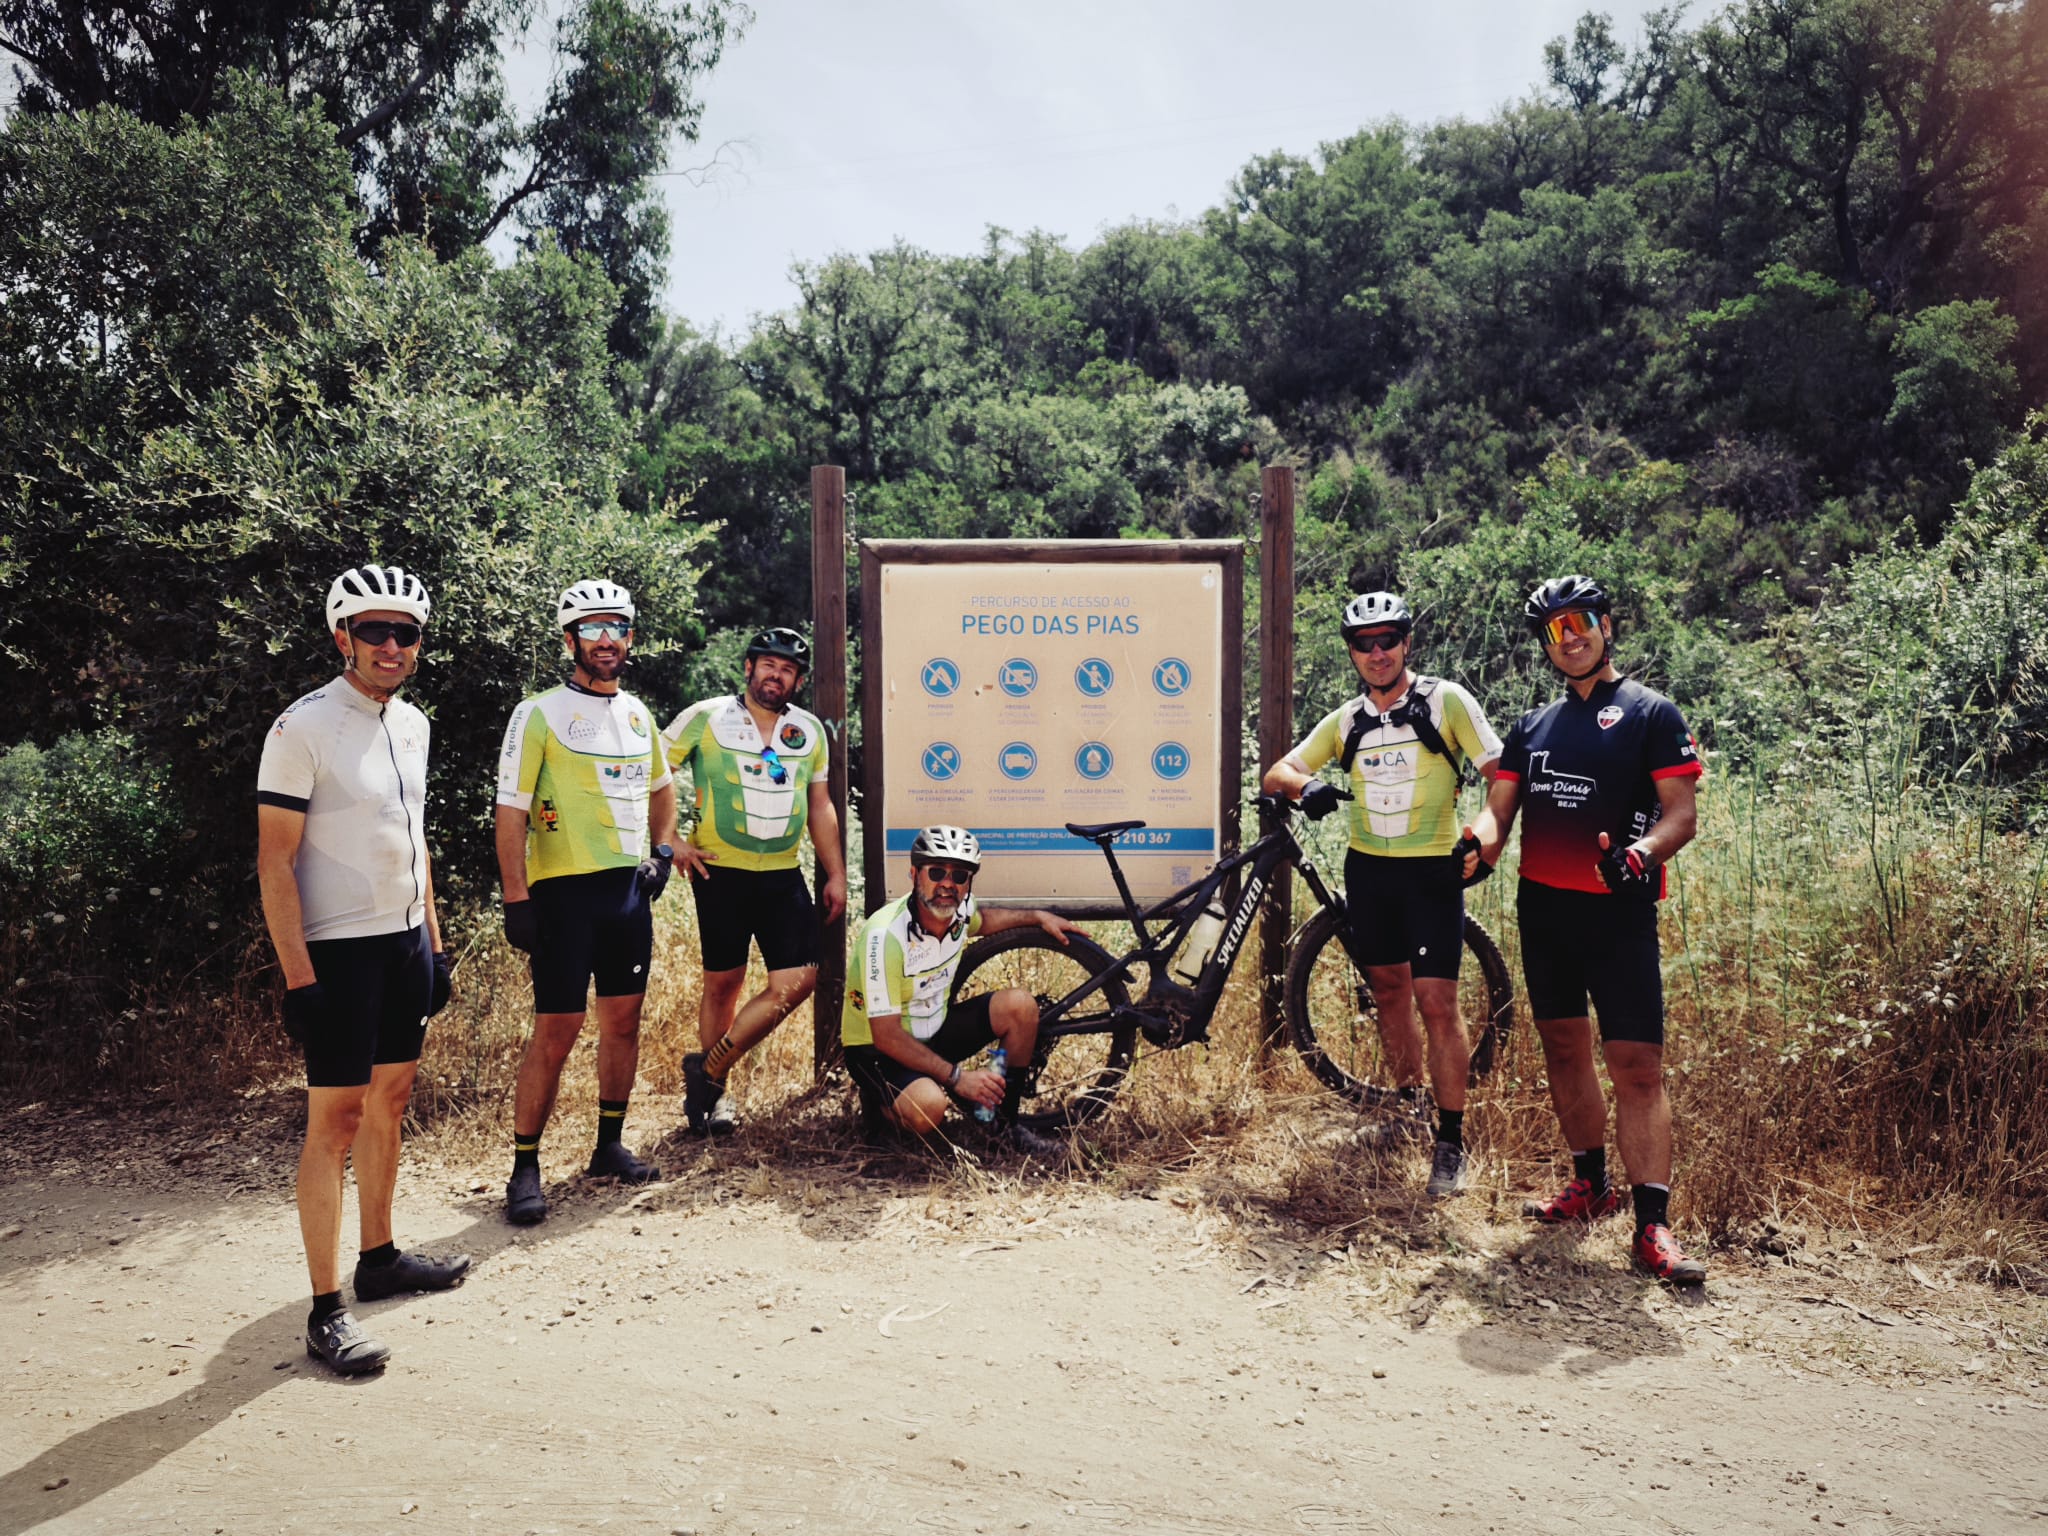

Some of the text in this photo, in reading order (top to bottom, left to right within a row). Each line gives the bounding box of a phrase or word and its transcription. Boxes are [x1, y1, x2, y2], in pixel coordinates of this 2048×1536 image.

[971, 596, 1130, 608] PERCURSO DE ACESSO AO
[962, 615, 1140, 635] PEGO DAS PIAS
[505, 710, 524, 758] Agrobeja
[1159, 755, 1182, 767] 112
[1383, 751, 1408, 767] CA
[625, 764, 645, 780] CA
[1530, 780, 1592, 795] Dom Dinis
[1557, 800, 1578, 808] BEJA
[1123, 832, 1146, 844] 210
[1148, 832, 1172, 844] 367
[1217, 876, 1264, 970] SPECIALIZED
[869, 935, 880, 982] Agrobeja
